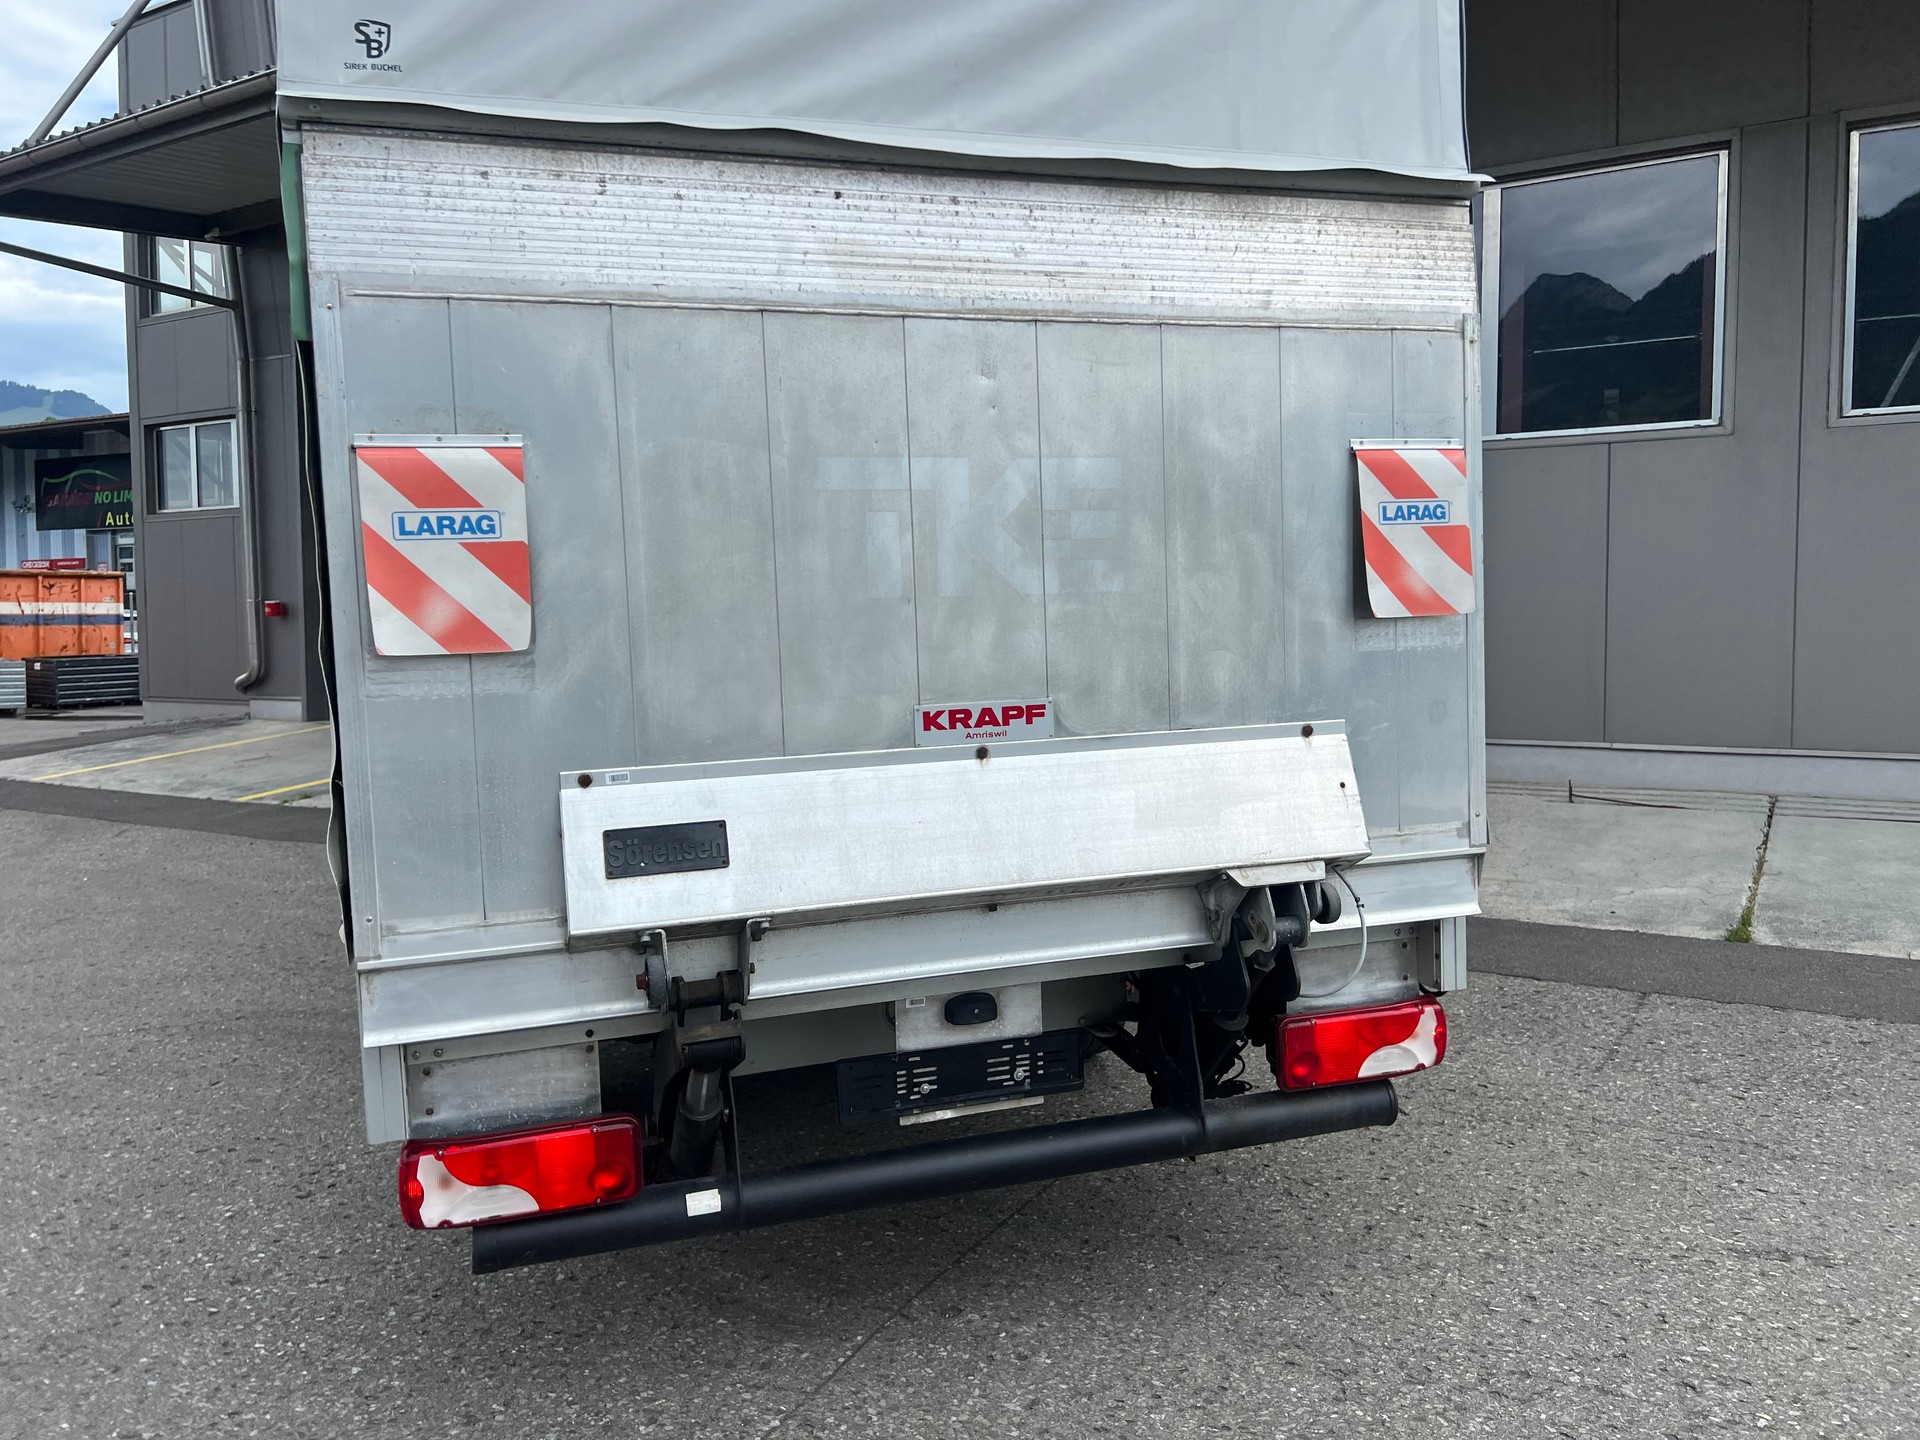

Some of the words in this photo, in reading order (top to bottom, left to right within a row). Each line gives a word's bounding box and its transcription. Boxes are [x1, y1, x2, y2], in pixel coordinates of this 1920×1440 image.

[343, 62, 368, 70] SIREK
[94, 491, 112, 504] NO
[1382, 503, 1447, 522] LARAG
[397, 514, 497, 536] LARAG
[922, 703, 1047, 732] KRAPF
[965, 729, 1008, 740] Amriswil
[607, 837, 726, 868] Sörensen
